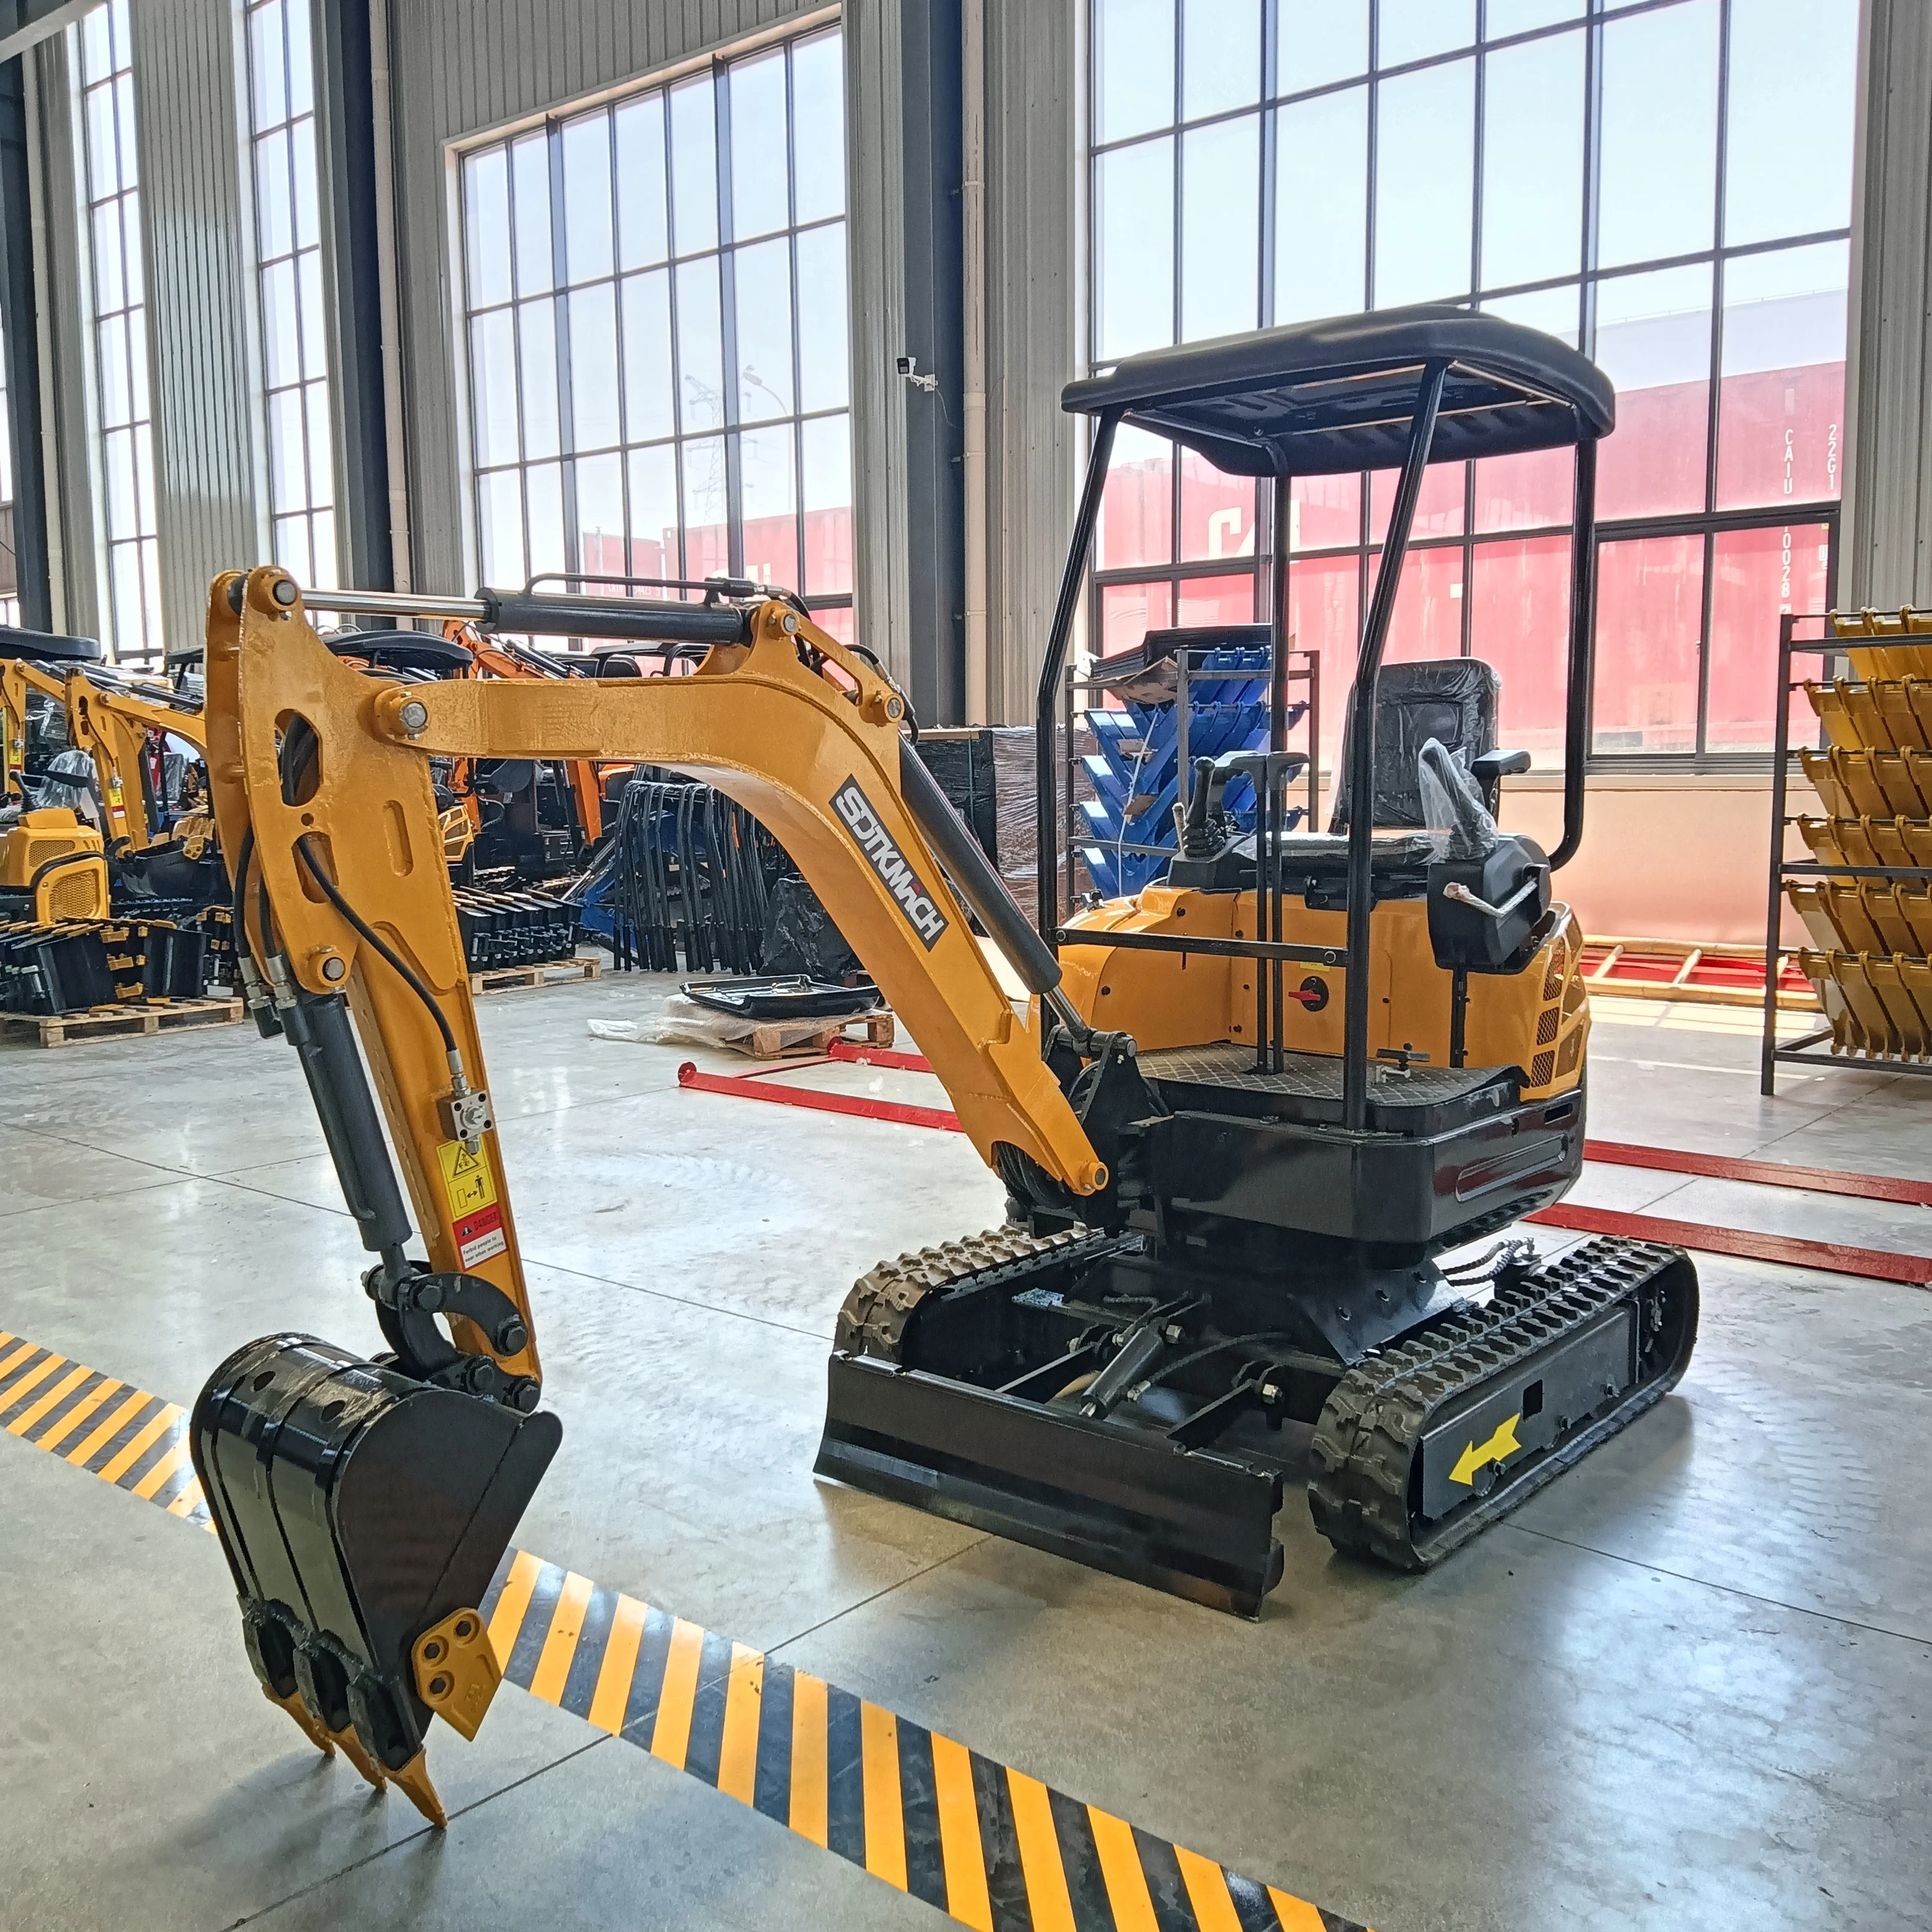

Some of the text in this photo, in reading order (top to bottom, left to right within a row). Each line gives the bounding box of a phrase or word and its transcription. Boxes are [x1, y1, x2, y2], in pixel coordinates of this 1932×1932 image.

[1783, 429, 1794, 495] CAIU
[1827, 424, 1837, 490] 22G1
[463, 1245, 477, 1255] Forbid
[477, 1239, 491, 1249] people
[475, 1250, 487, 1258] when
[487, 1241, 504, 1251] working
